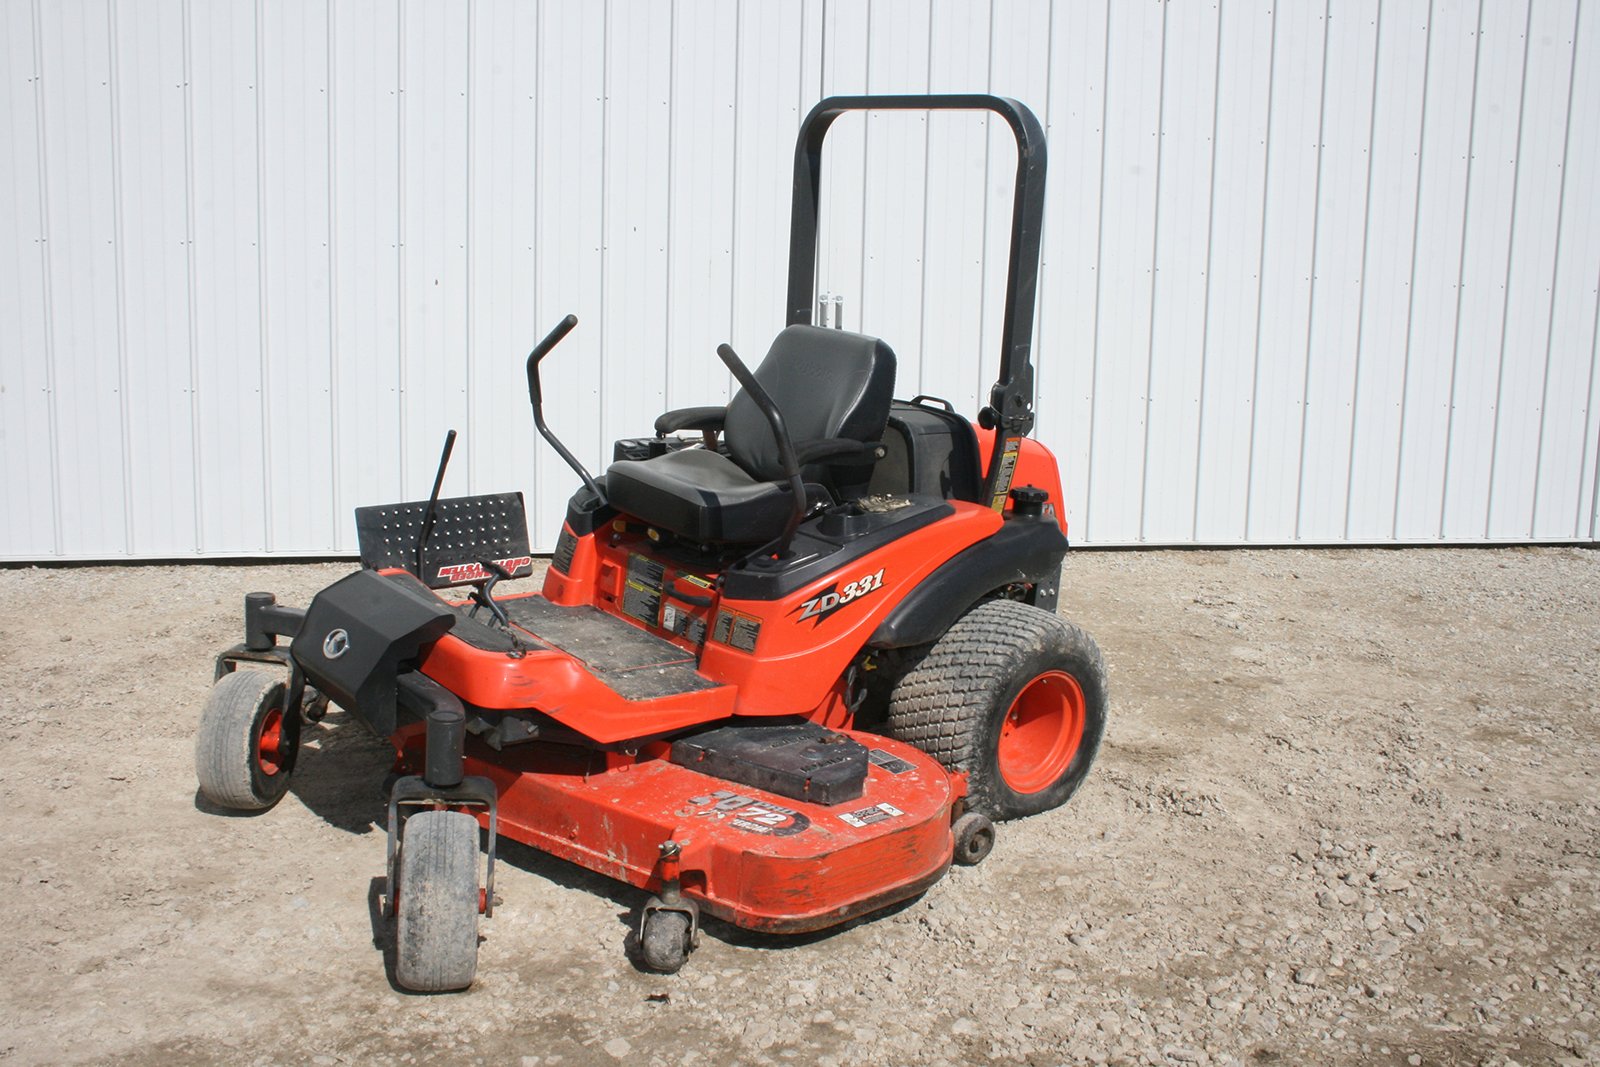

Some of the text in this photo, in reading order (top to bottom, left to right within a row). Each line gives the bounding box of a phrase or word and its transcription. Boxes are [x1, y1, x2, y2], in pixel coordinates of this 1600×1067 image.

[438, 562, 482, 577] YSTEM
[798, 568, 885, 622] ZD331
[737, 806, 787, 825] 72
